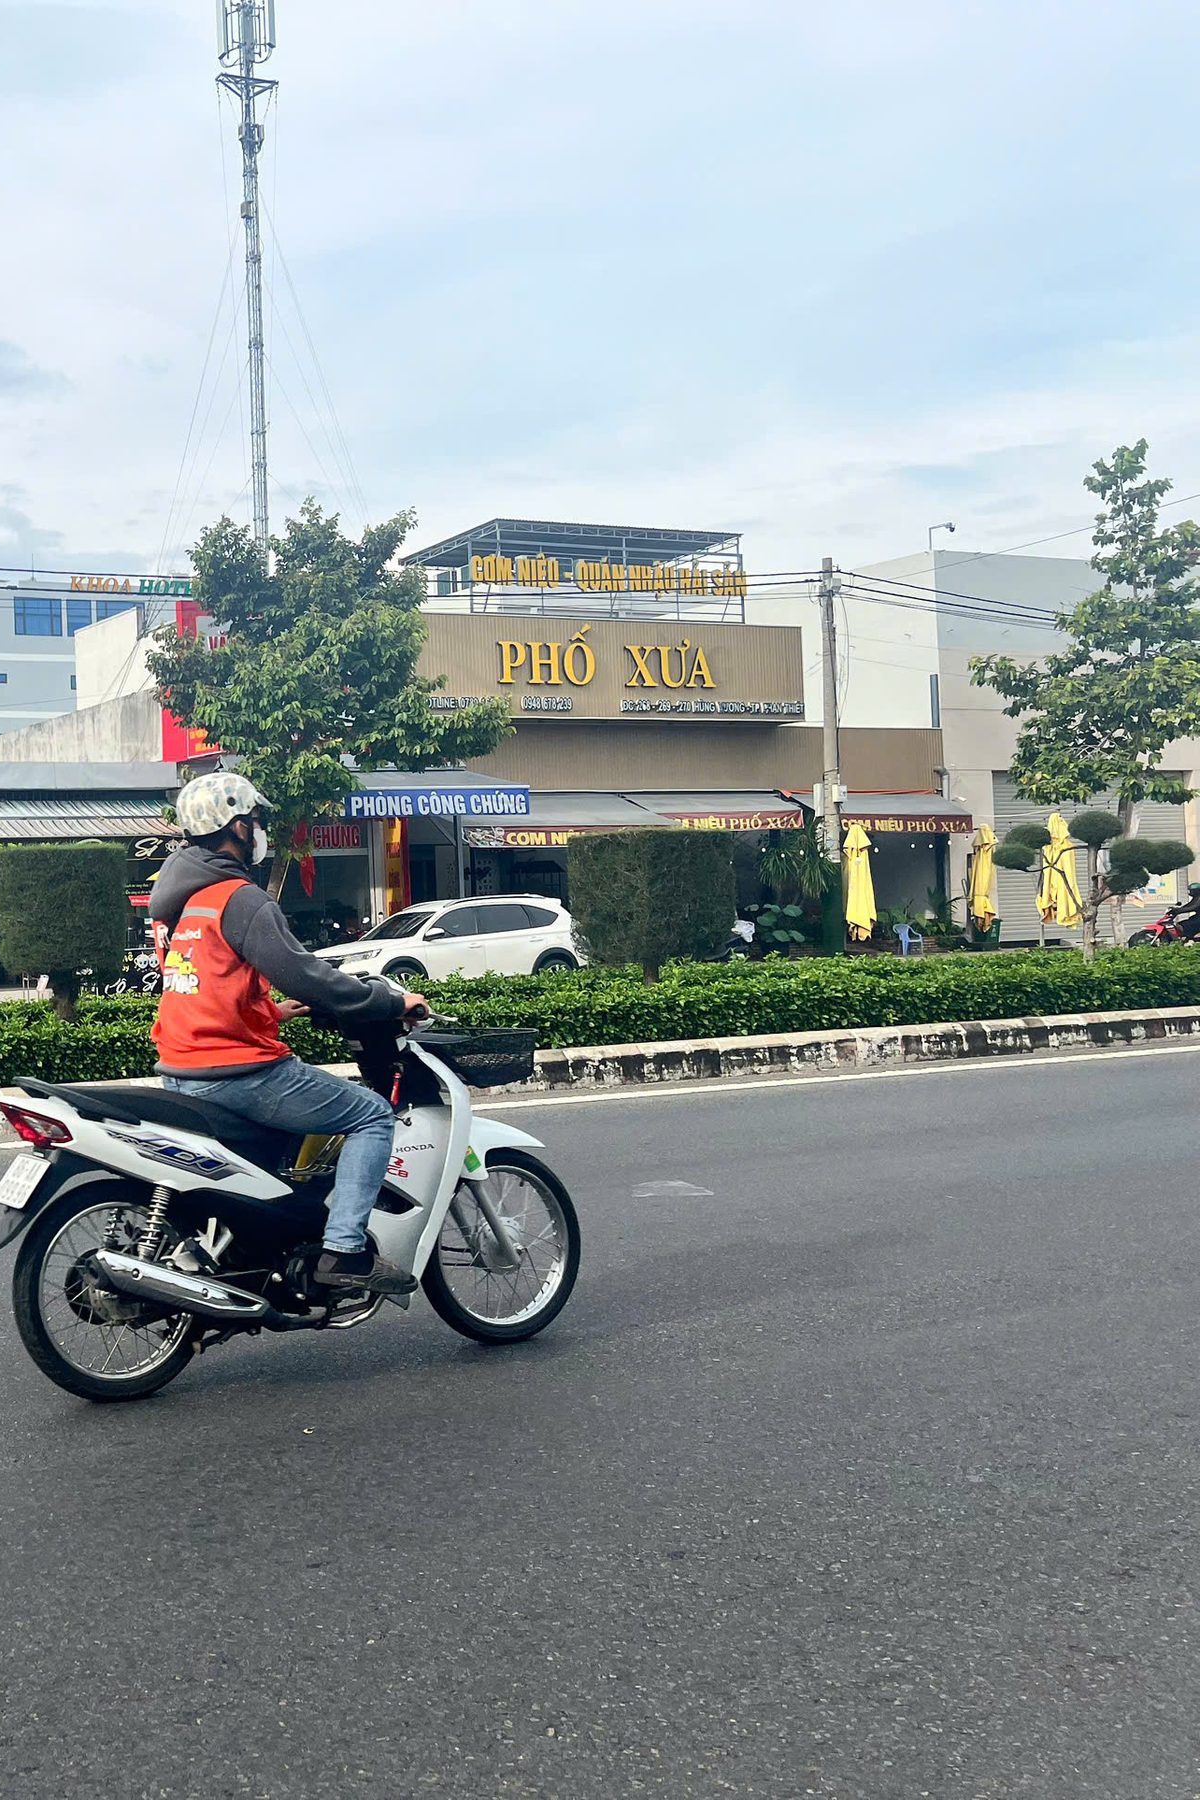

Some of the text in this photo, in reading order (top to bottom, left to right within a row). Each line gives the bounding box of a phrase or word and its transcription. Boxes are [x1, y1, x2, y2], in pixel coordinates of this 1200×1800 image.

[471, 554, 513, 586] CƠM
[576, 556, 625, 592] QUÁN
[71, 575, 132, 594] KHOA
[497, 623, 717, 688] PHỐ XƯA
[351, 791, 414, 817] PHÒNG
[417, 791, 467, 816] CÔNG
[469, 790, 527, 815] CHỨNG
[729, 812, 762, 830] PHỐ
[907, 816, 937, 832] PHỐ
[395, 1143, 435, 1153] HONDA
